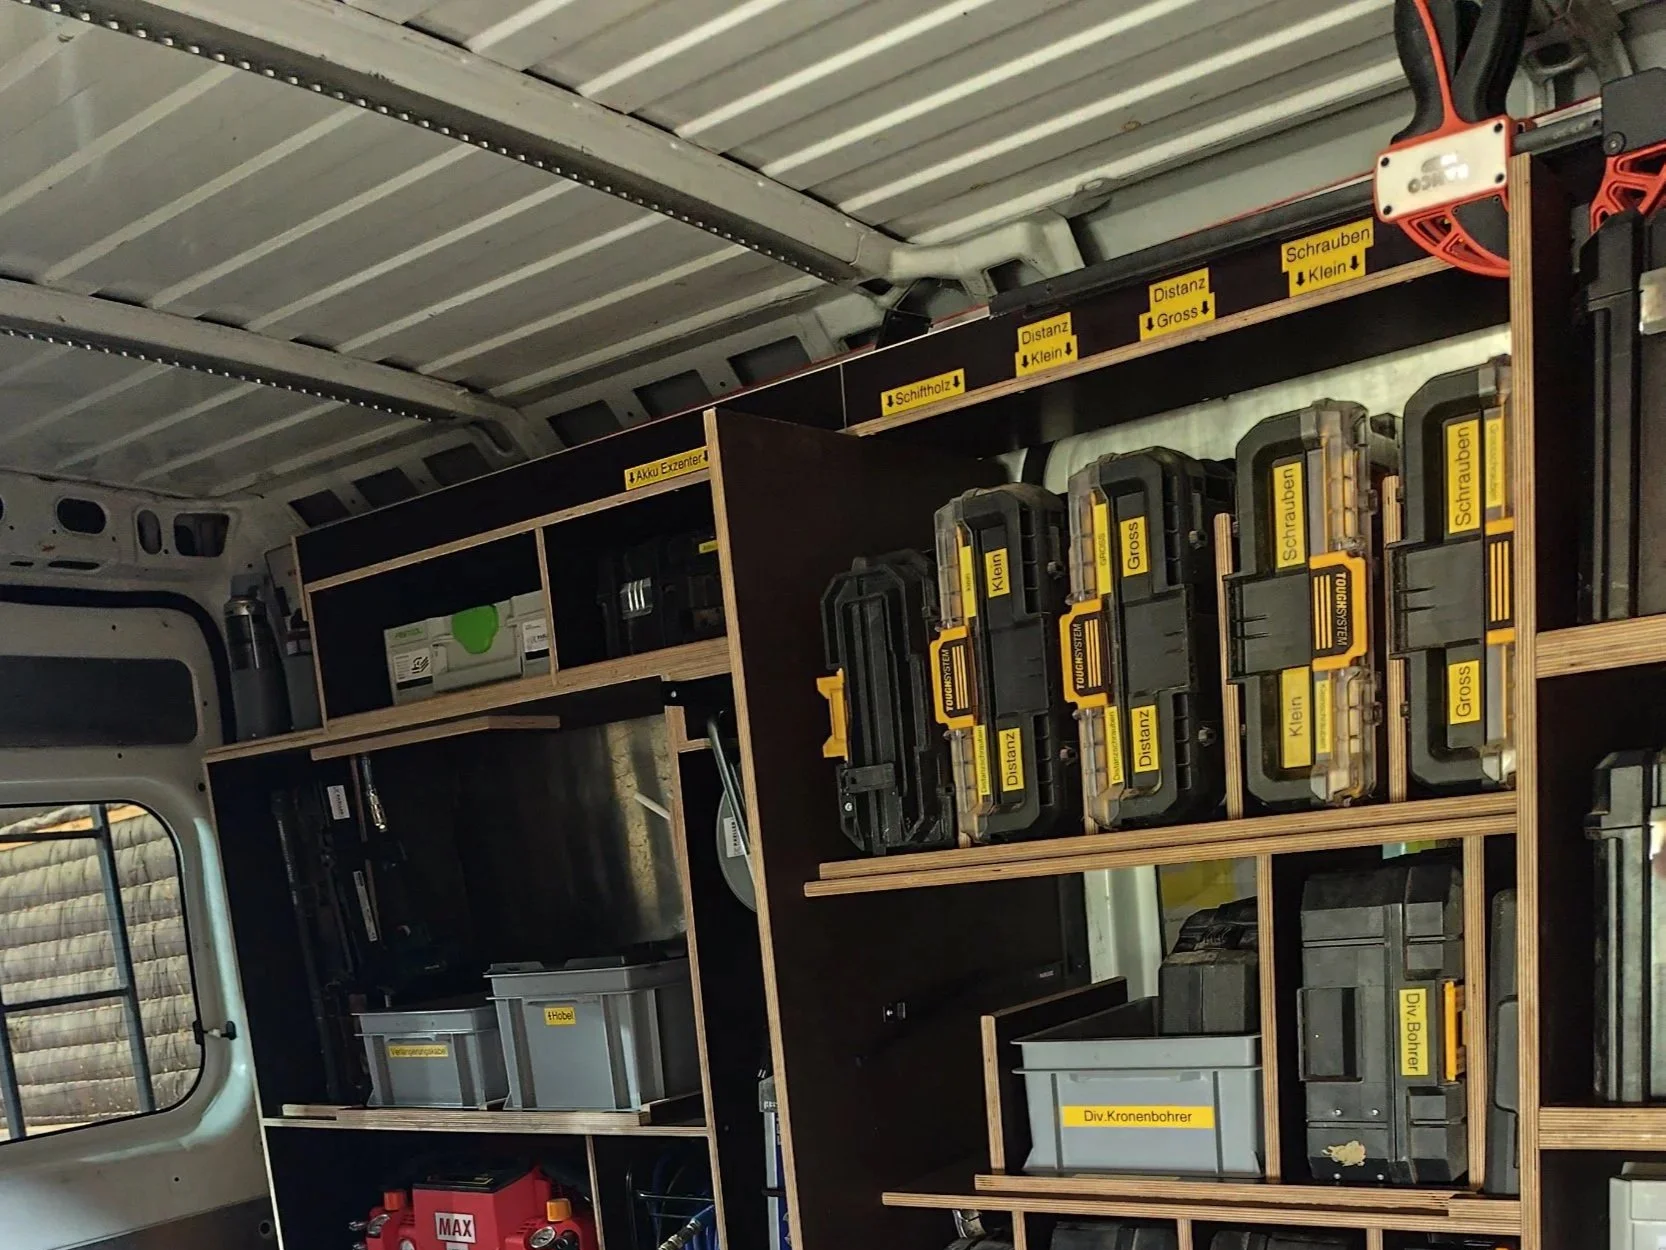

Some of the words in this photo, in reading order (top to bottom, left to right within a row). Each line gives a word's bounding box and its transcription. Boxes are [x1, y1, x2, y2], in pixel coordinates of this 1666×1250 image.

[1286, 228, 1370, 263] Schrauben
[1153, 278, 1206, 303] Distanz
[1308, 261, 1347, 284] Klein
[1021, 322, 1068, 345] Distanz
[1156, 307, 1199, 328] Gross
[1031, 347, 1063, 366] Klein
[895, 380, 951, 405] Schiftholz
[636, 467, 659, 481] Akku
[660, 454, 702, 475] Exzenter
[1455, 425, 1471, 526] Schrauben
[1282, 466, 1297, 562] Schrauben
[1127, 521, 1139, 570] Gross
[992, 553, 1003, 592] Klein
[1337, 571, 1347, 647] TOUGHSYSTEM
[942, 648, 953, 712] TOUGHSYSTEM
[1456, 664, 1471, 718] Gross
[1289, 694, 1303, 737] Klein
[1139, 709, 1151, 768] Distanz
[1006, 731, 1018, 787] Distanz
[552, 1010, 575, 1021] Hobel
[1406, 992, 1421, 1072] Div.Bohrer
[1083, 1109, 1193, 1123] Div.Kronenbohrer
[439, 1217, 472, 1238] MAX
